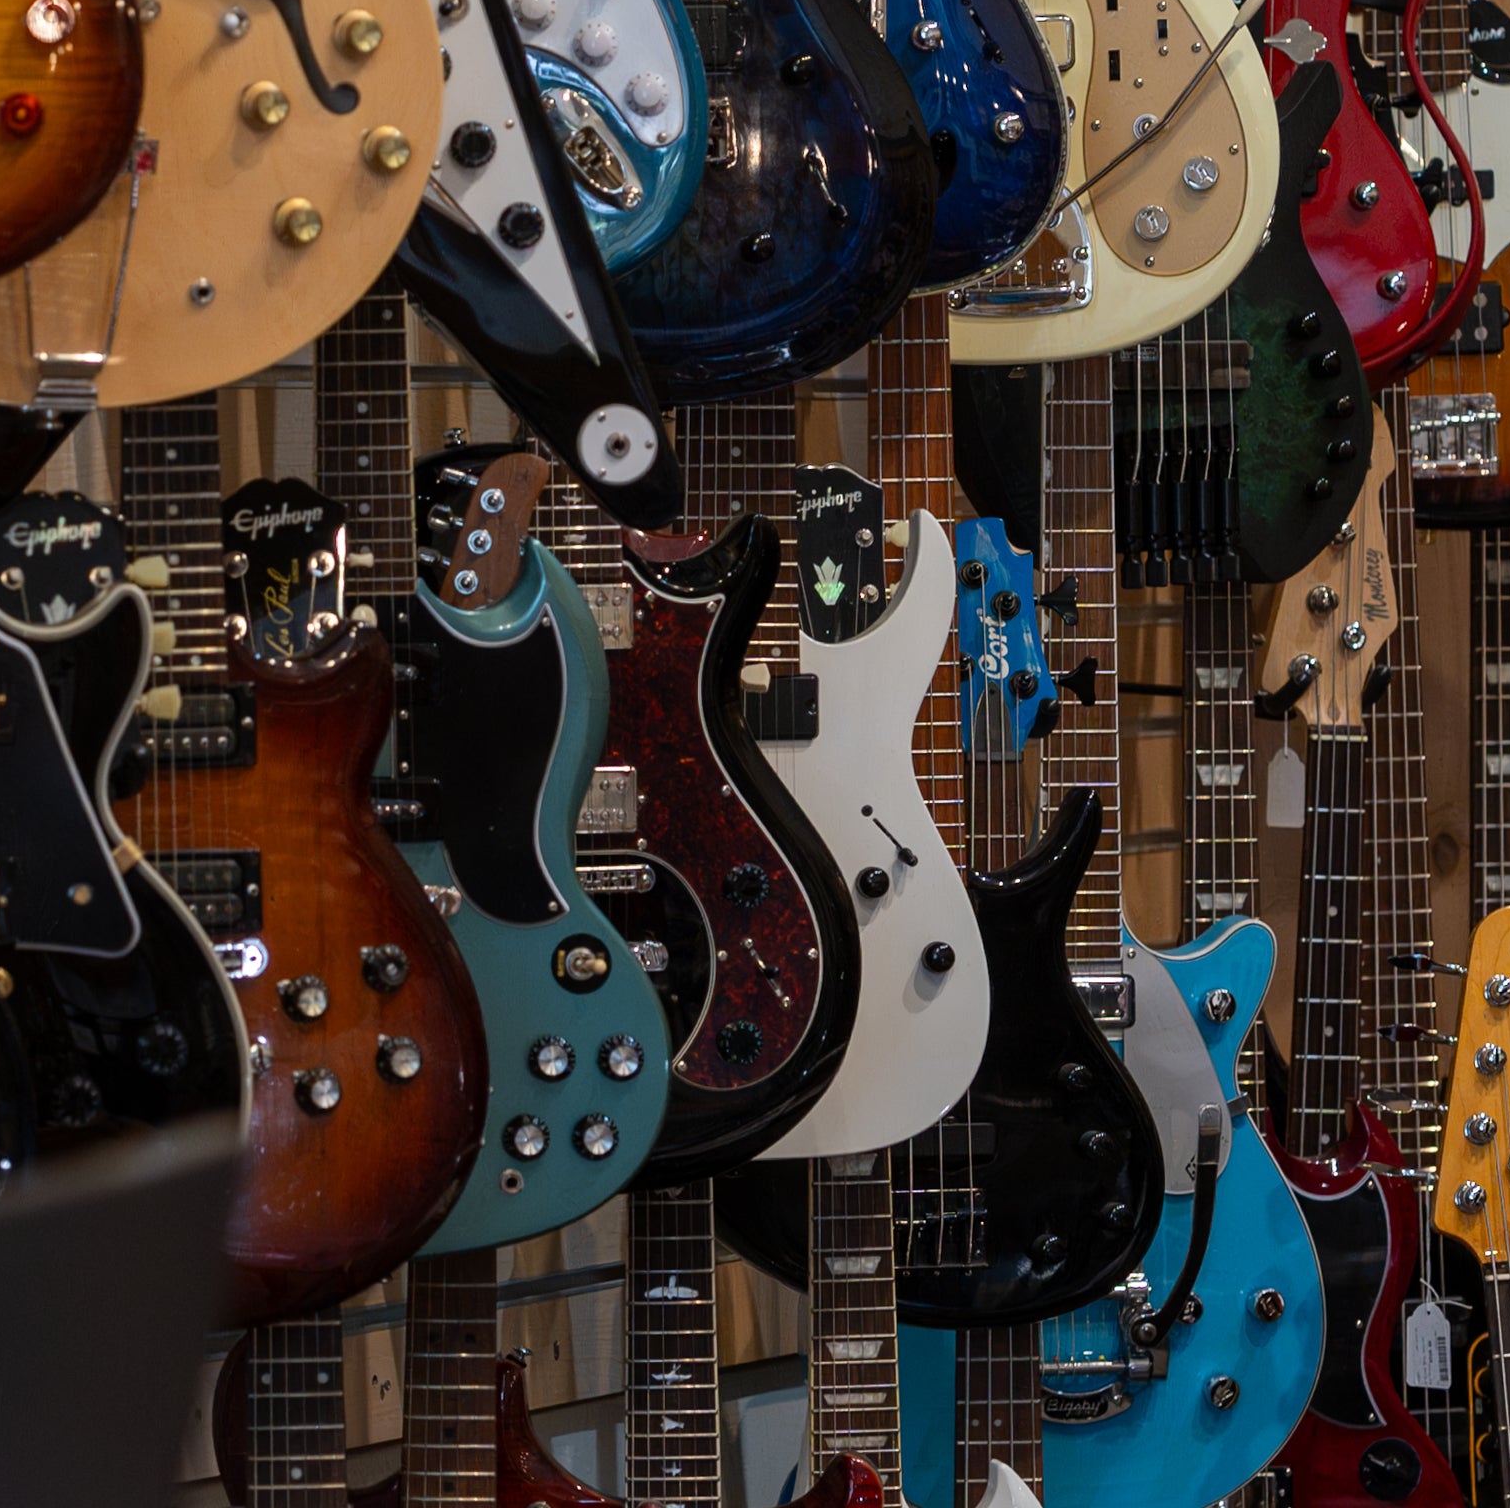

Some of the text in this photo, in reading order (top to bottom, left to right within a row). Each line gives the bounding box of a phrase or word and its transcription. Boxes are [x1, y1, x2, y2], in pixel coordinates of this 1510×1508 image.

[3, 515, 102, 557] Epiphone
[228, 502, 324, 541] Epiphone
[264, 567, 294, 625] Paul
[1363, 548, 1390, 622] Monterey
[977, 609, 1010, 680] Cort
[1045, 1397, 1102, 1418] Bigsby
